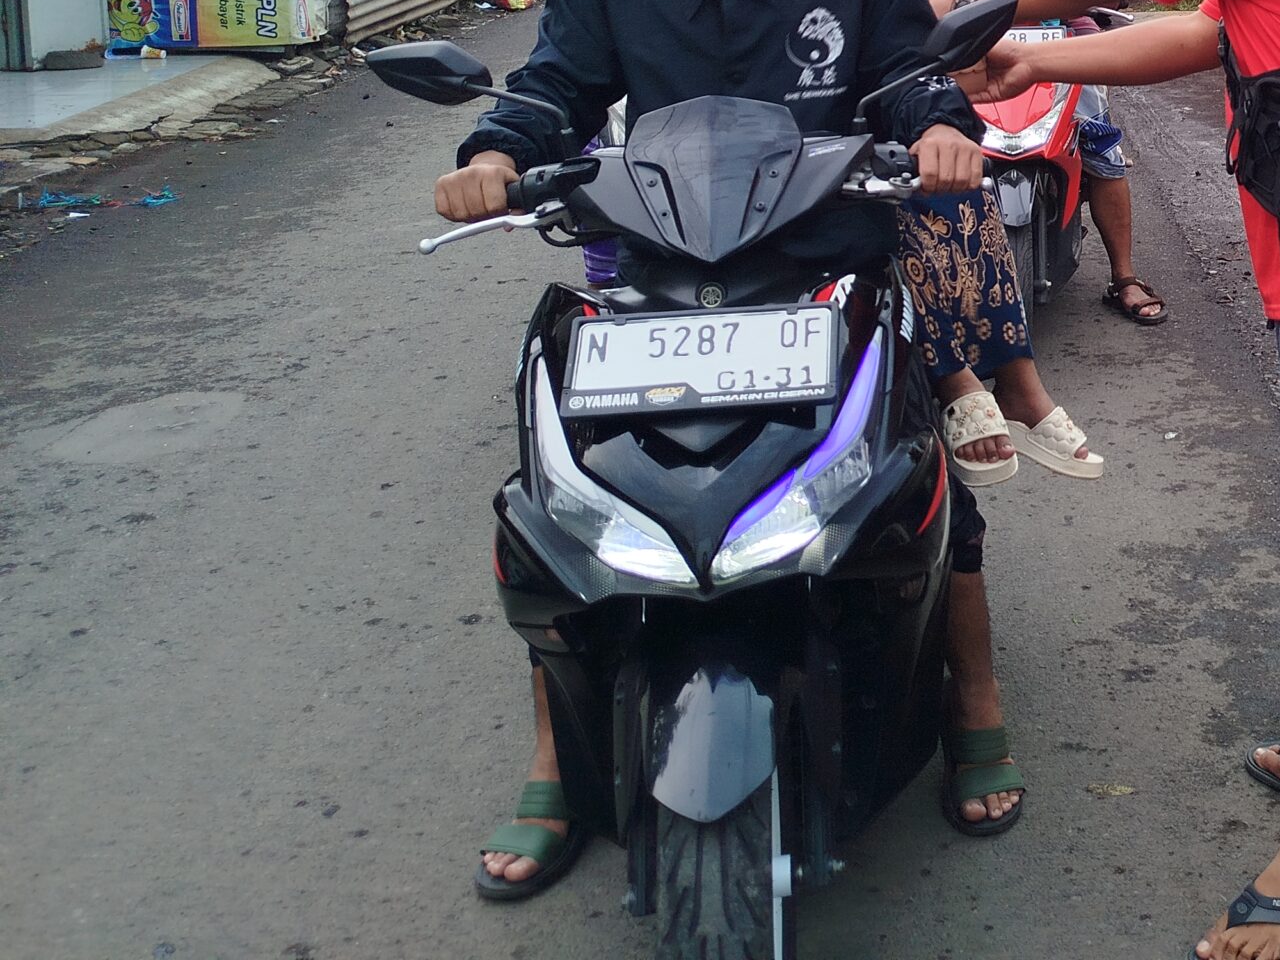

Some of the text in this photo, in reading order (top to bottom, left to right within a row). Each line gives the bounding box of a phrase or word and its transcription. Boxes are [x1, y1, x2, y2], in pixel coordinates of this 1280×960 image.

[587, 332, 608, 363] N
[648, 322, 740, 358] 5287
[585, 392, 639, 409] YAMAHA
[701, 387, 825, 404] SEMAKIN DI DEPAN
